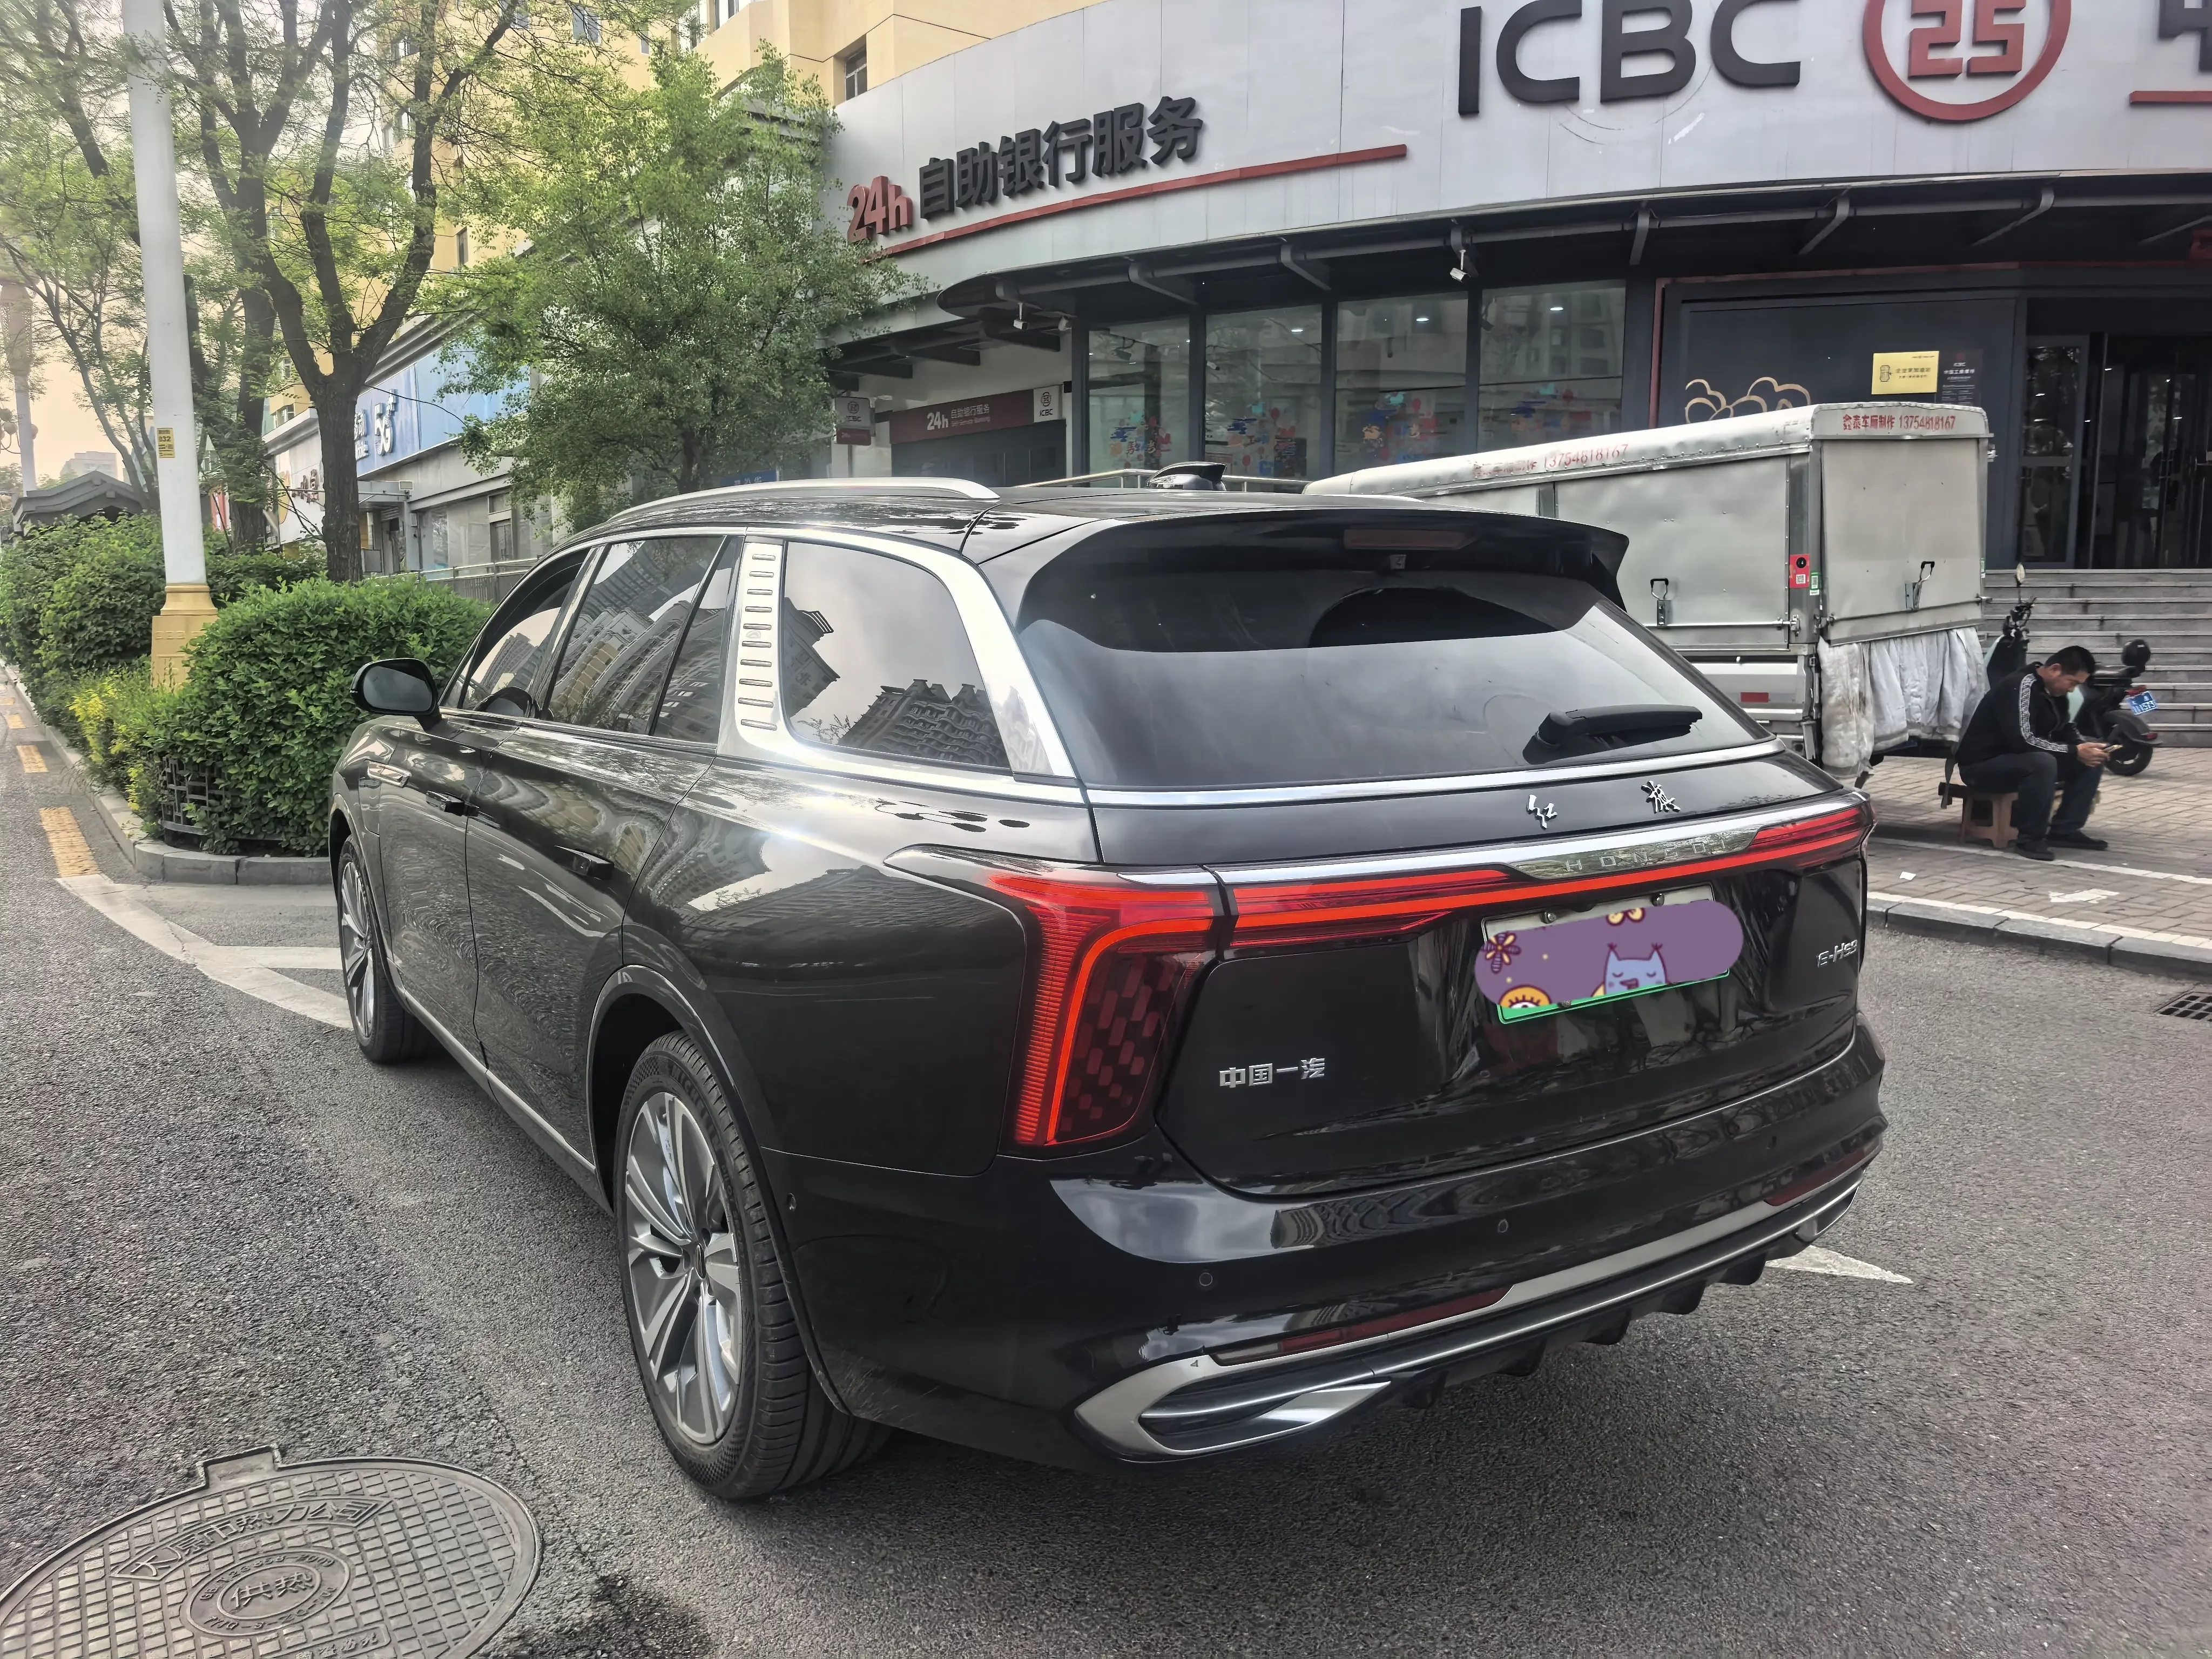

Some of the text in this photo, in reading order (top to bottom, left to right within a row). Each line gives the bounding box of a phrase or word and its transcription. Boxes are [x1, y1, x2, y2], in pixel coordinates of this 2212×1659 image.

[1458, 0, 1801, 116] ICBC
[847, 96, 1204, 242] 24h 自助银行服务
[927, 412, 949, 430] 24h
[951, 404, 989, 419] 自助银行服务
[1899, 415, 1956, 430] 13754818167
[1816, 940, 1858, 968] E-HS9
[1219, 1058, 1325, 1088] 中国一汽
[130, 1501, 378, 1576] 太原市热力公司
[231, 1572, 313, 1608] 供热
